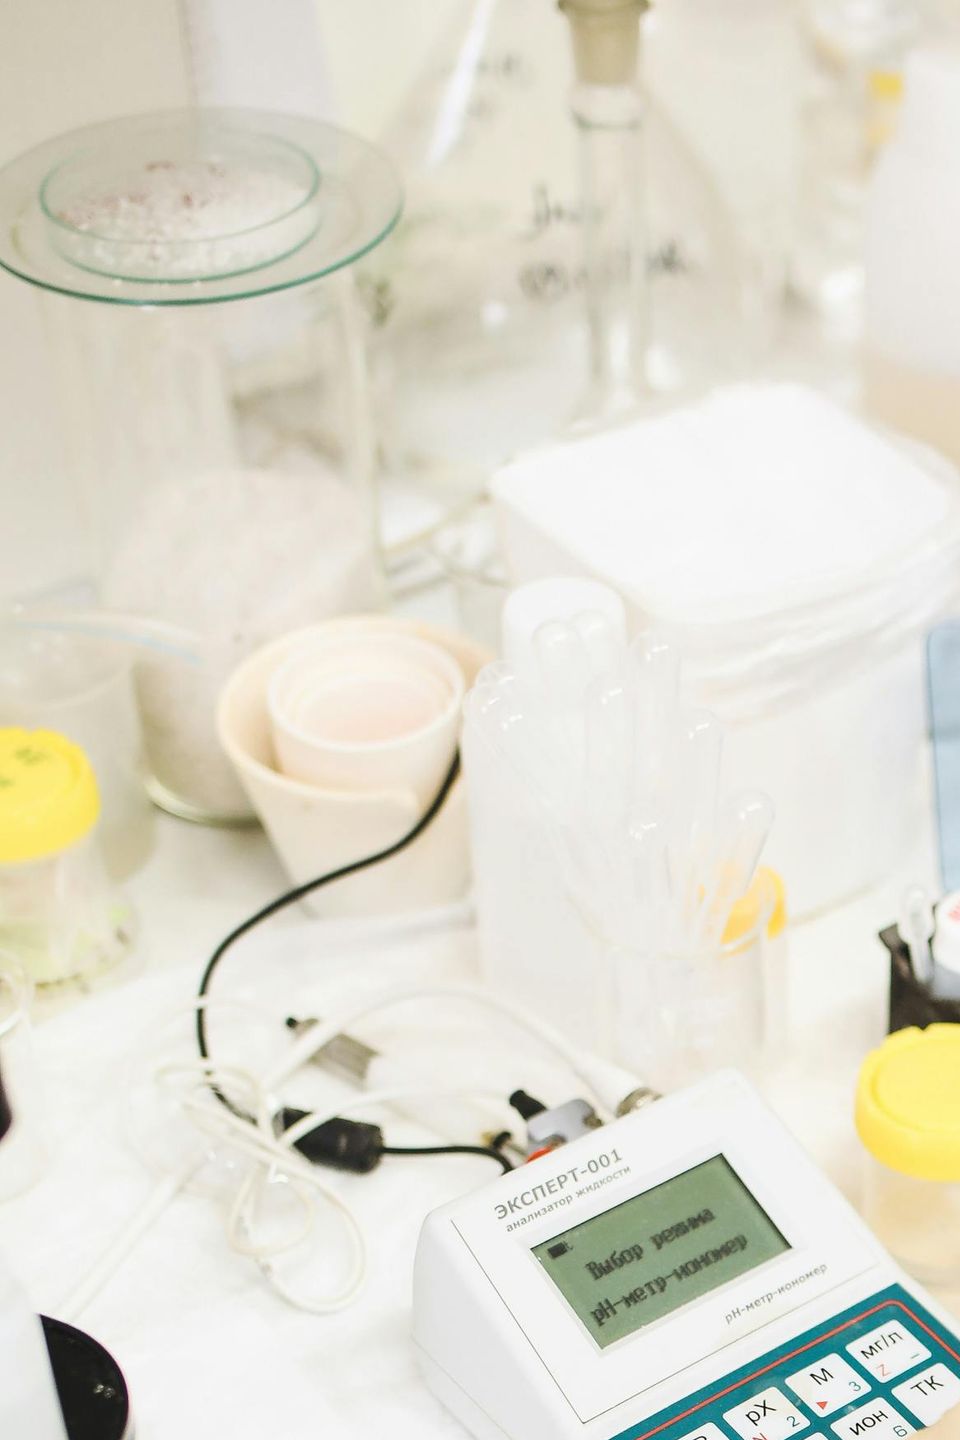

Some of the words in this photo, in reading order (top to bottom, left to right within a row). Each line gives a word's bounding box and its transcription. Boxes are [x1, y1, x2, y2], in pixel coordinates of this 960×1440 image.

[494, 1148, 622, 1220] ЭКСПЕРТ-001
[506, 1194, 574, 1232] анализатор
[575, 1166, 632, 1199] жидкости
[584, 1243, 644, 1281] Выбор
[650, 1208, 716, 1251] режима
[860, 1331, 904, 1359] мг/л
[876, 1363, 890, 1377] Z
[848, 1381, 861, 1391] 3
[786, 1415, 800, 1428] 2
[849, 1410, 889, 1436] ион
[893, 1425, 908, 1437] 6
